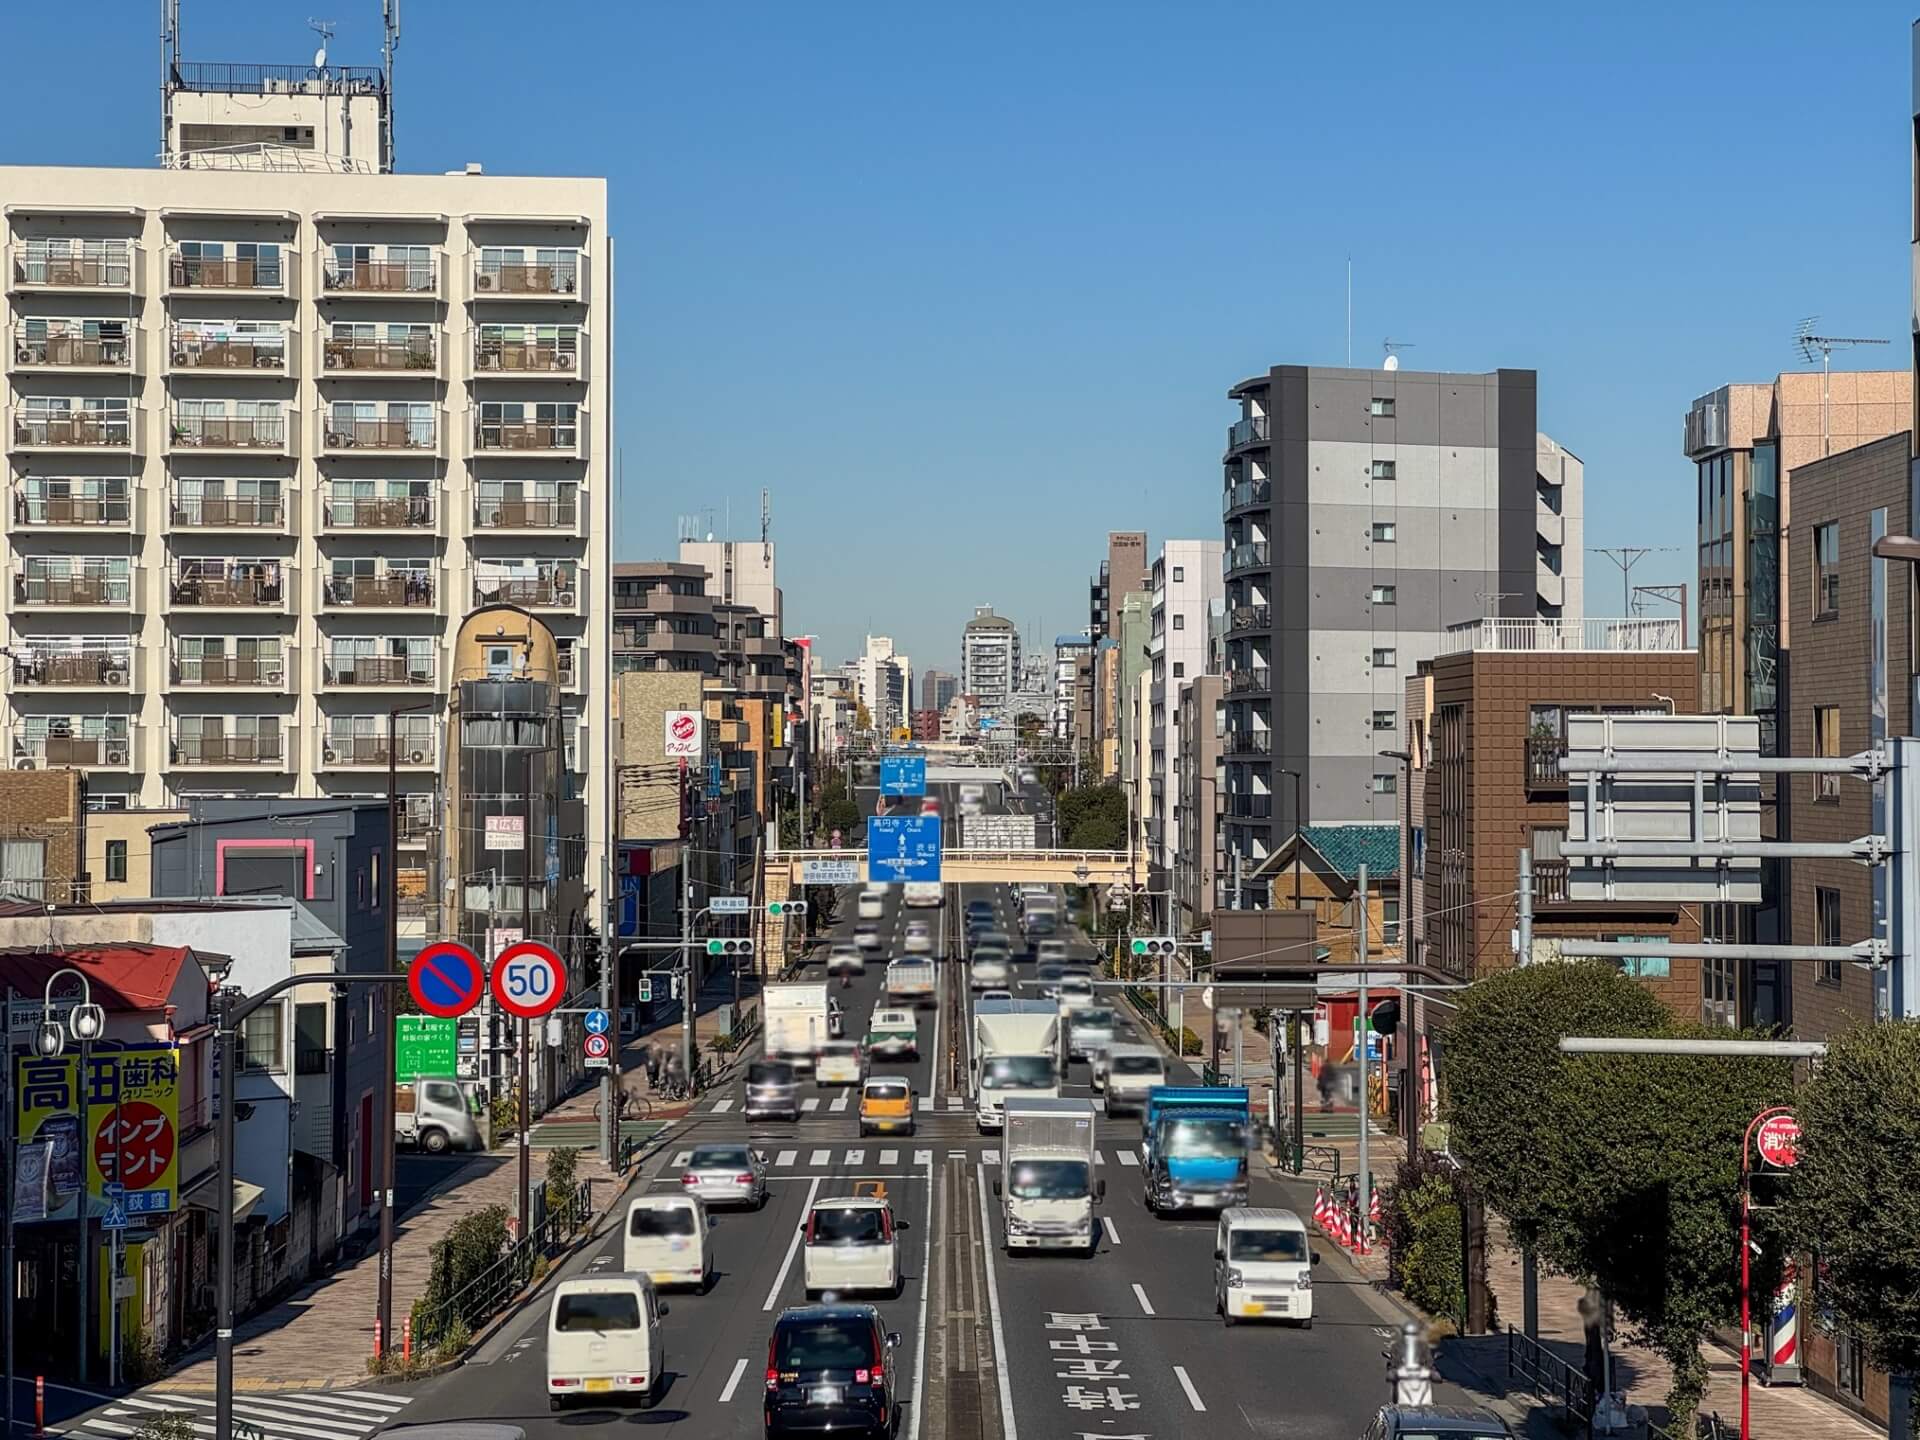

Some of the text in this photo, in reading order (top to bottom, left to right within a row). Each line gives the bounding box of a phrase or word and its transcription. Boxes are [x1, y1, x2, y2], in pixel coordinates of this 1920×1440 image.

[873, 818, 900, 827] 高円寺
[508, 964, 548, 996] 50
[99, 1114, 167, 1144] インプ
[99, 1149, 166, 1177] ラント
